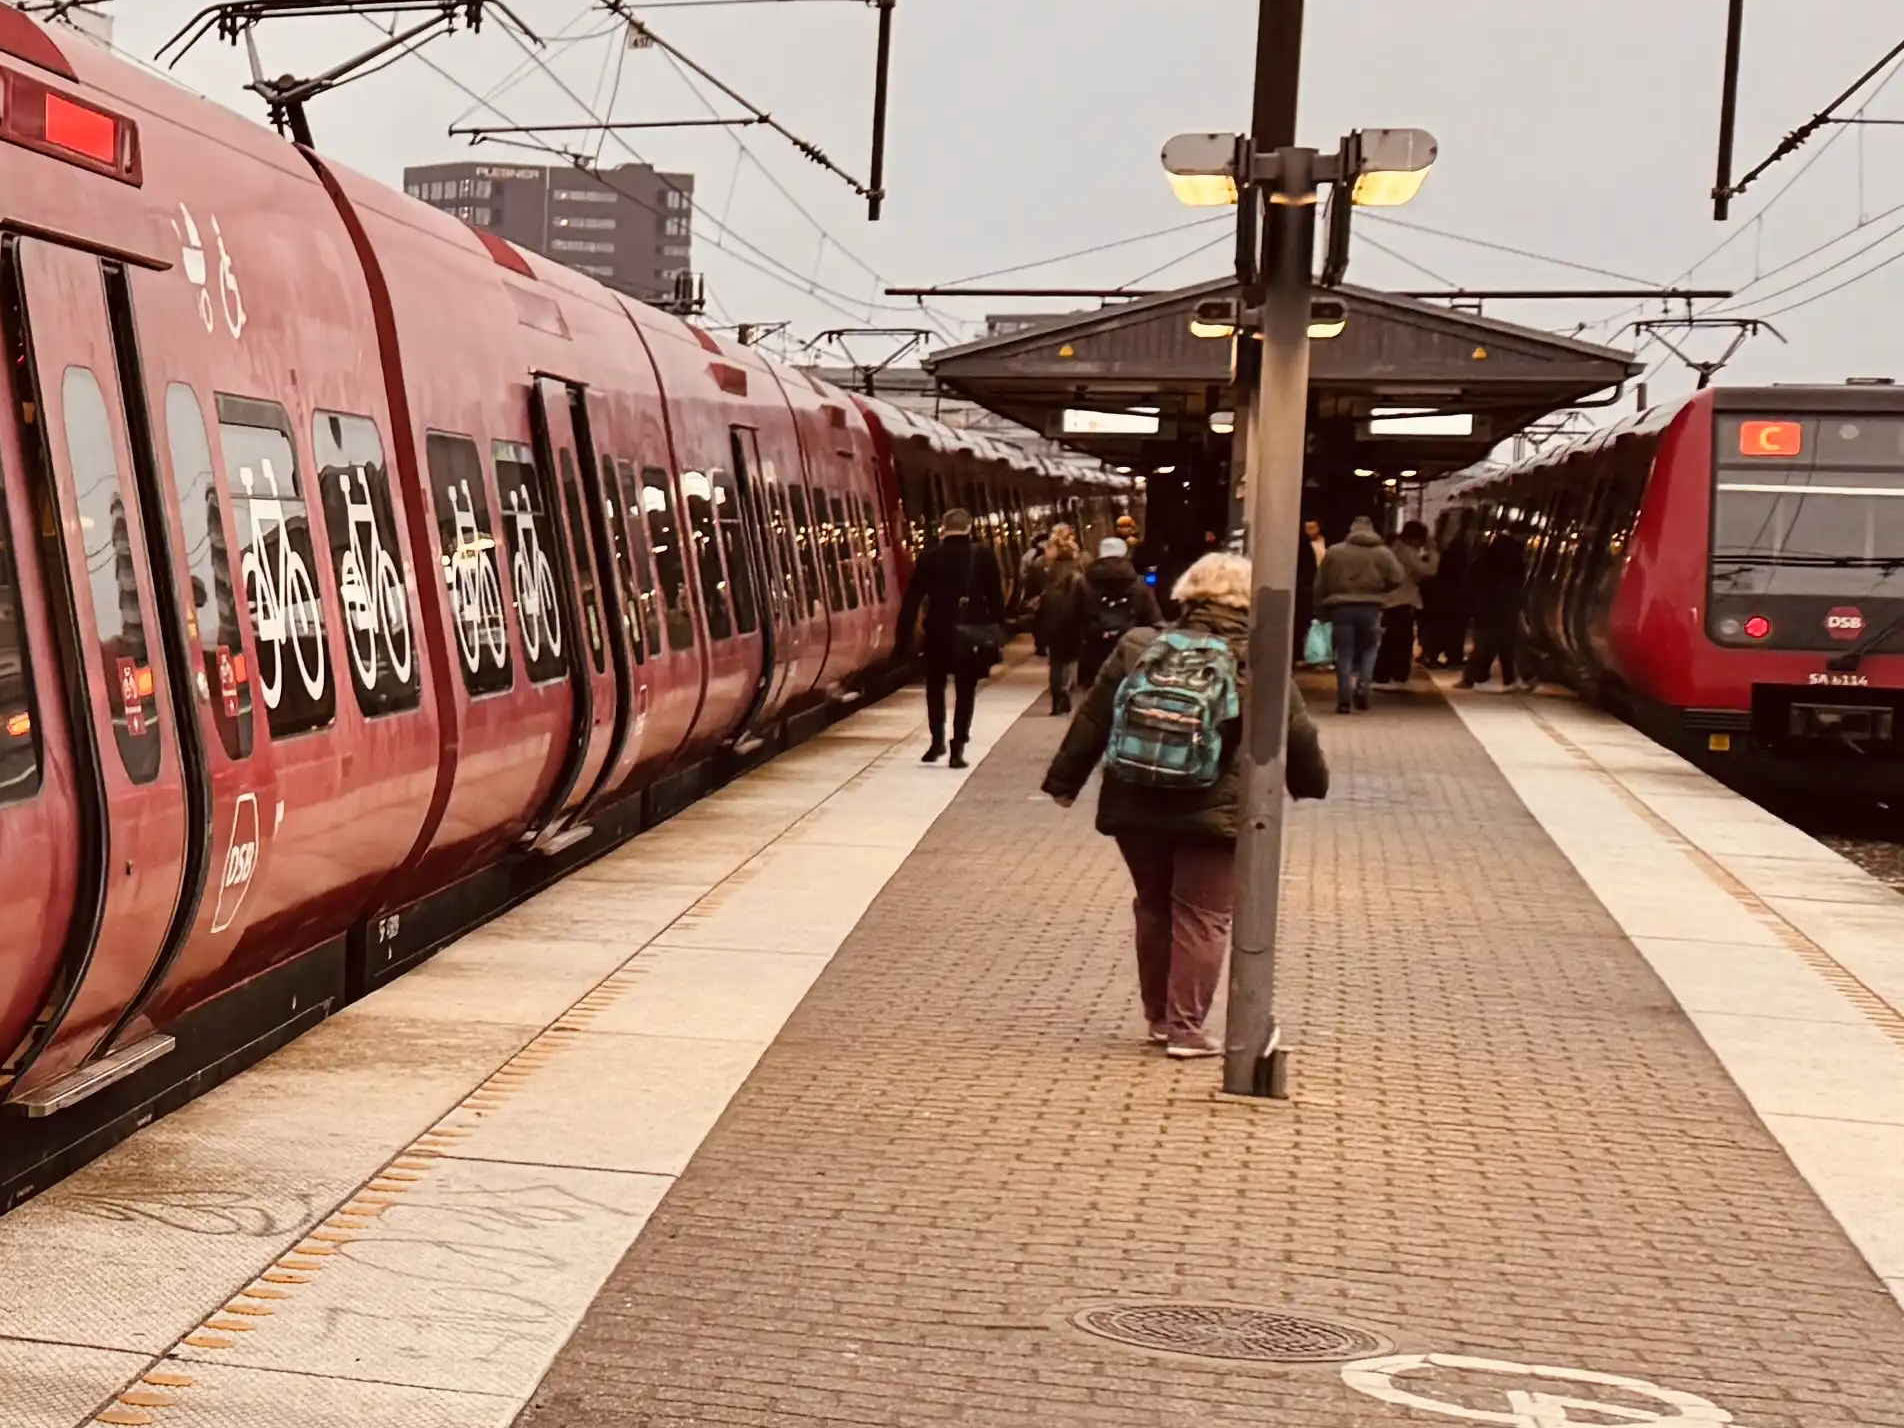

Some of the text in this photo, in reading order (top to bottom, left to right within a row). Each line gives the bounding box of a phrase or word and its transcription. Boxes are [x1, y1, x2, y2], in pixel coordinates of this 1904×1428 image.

[1758, 425, 1784, 452] C
[1827, 615, 1862, 629] DSB
[225, 841, 256, 888] DSB
